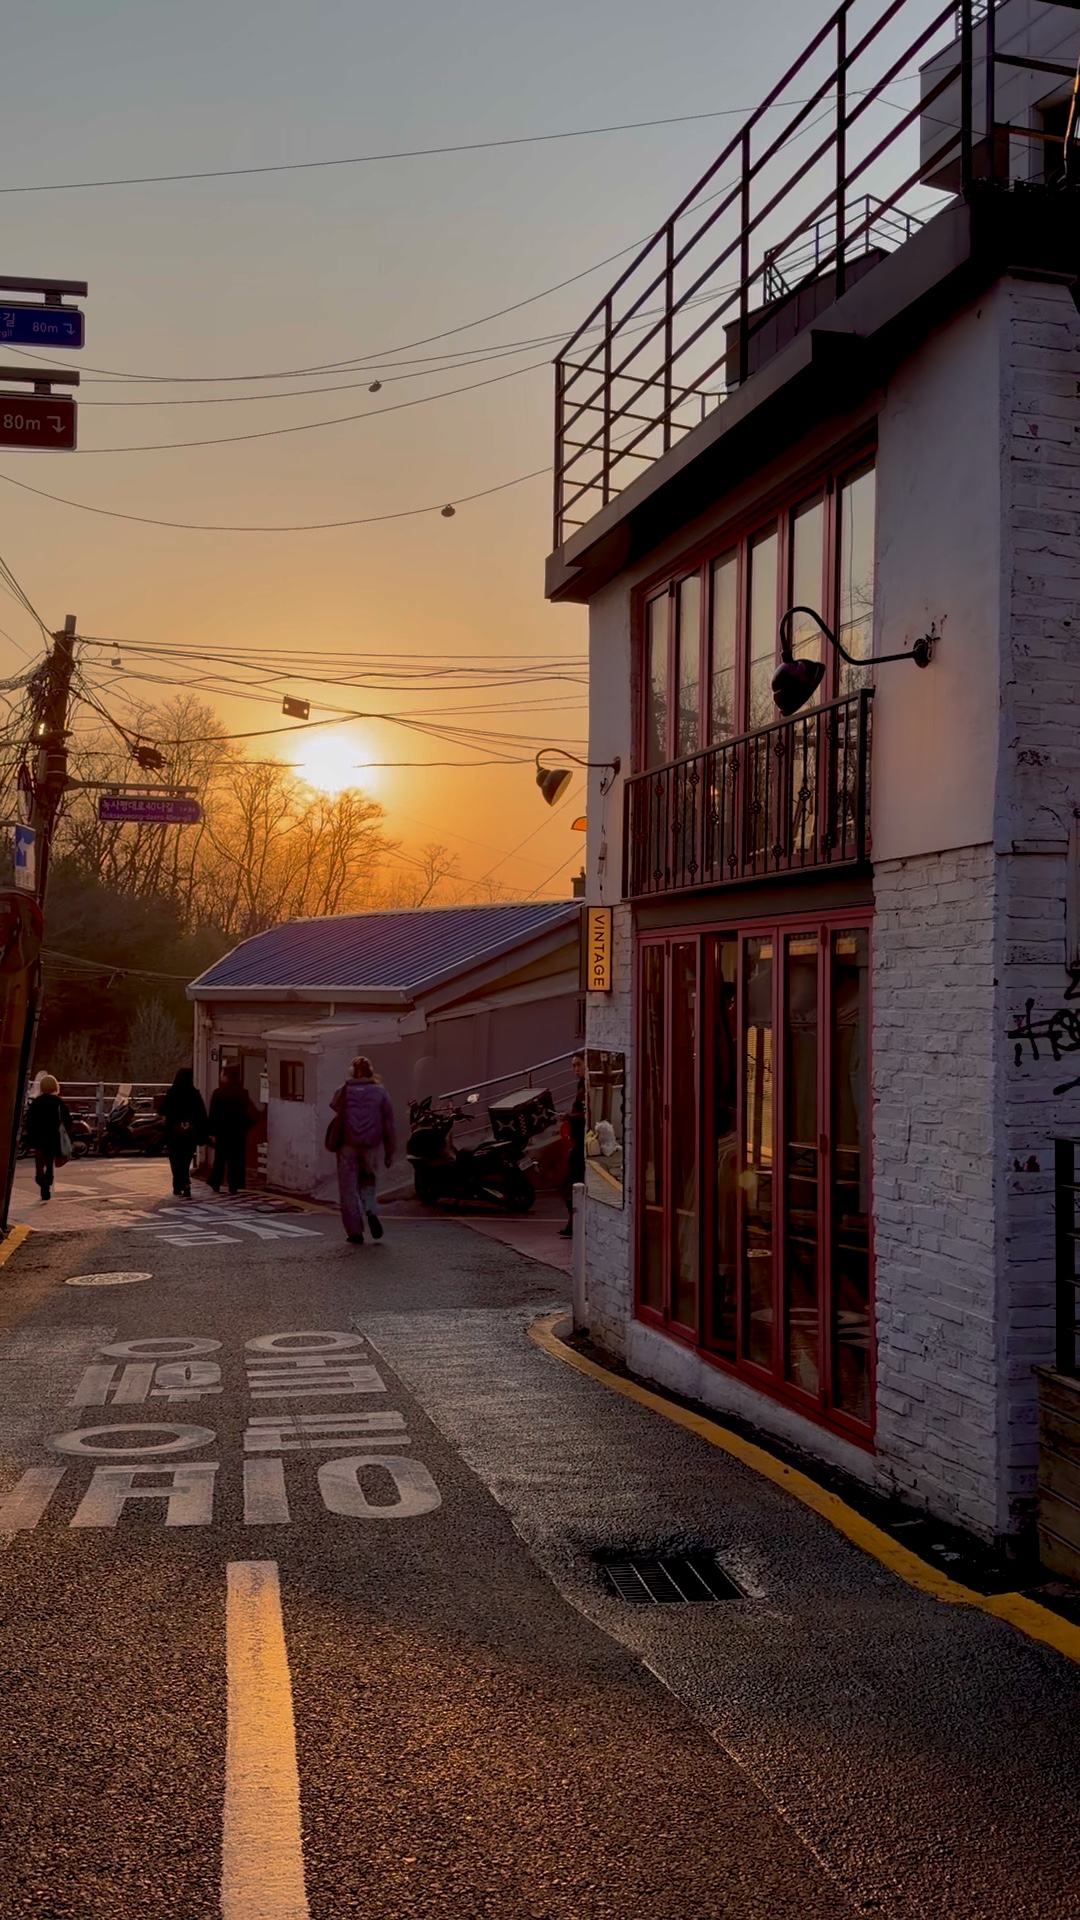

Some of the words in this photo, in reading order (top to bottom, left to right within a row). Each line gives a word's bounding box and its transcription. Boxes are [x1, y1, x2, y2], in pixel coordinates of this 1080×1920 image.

[32, 321, 59, 334] 80m
[3, 413, 41, 431] 80m
[593, 914, 606, 987] VINTAGE
